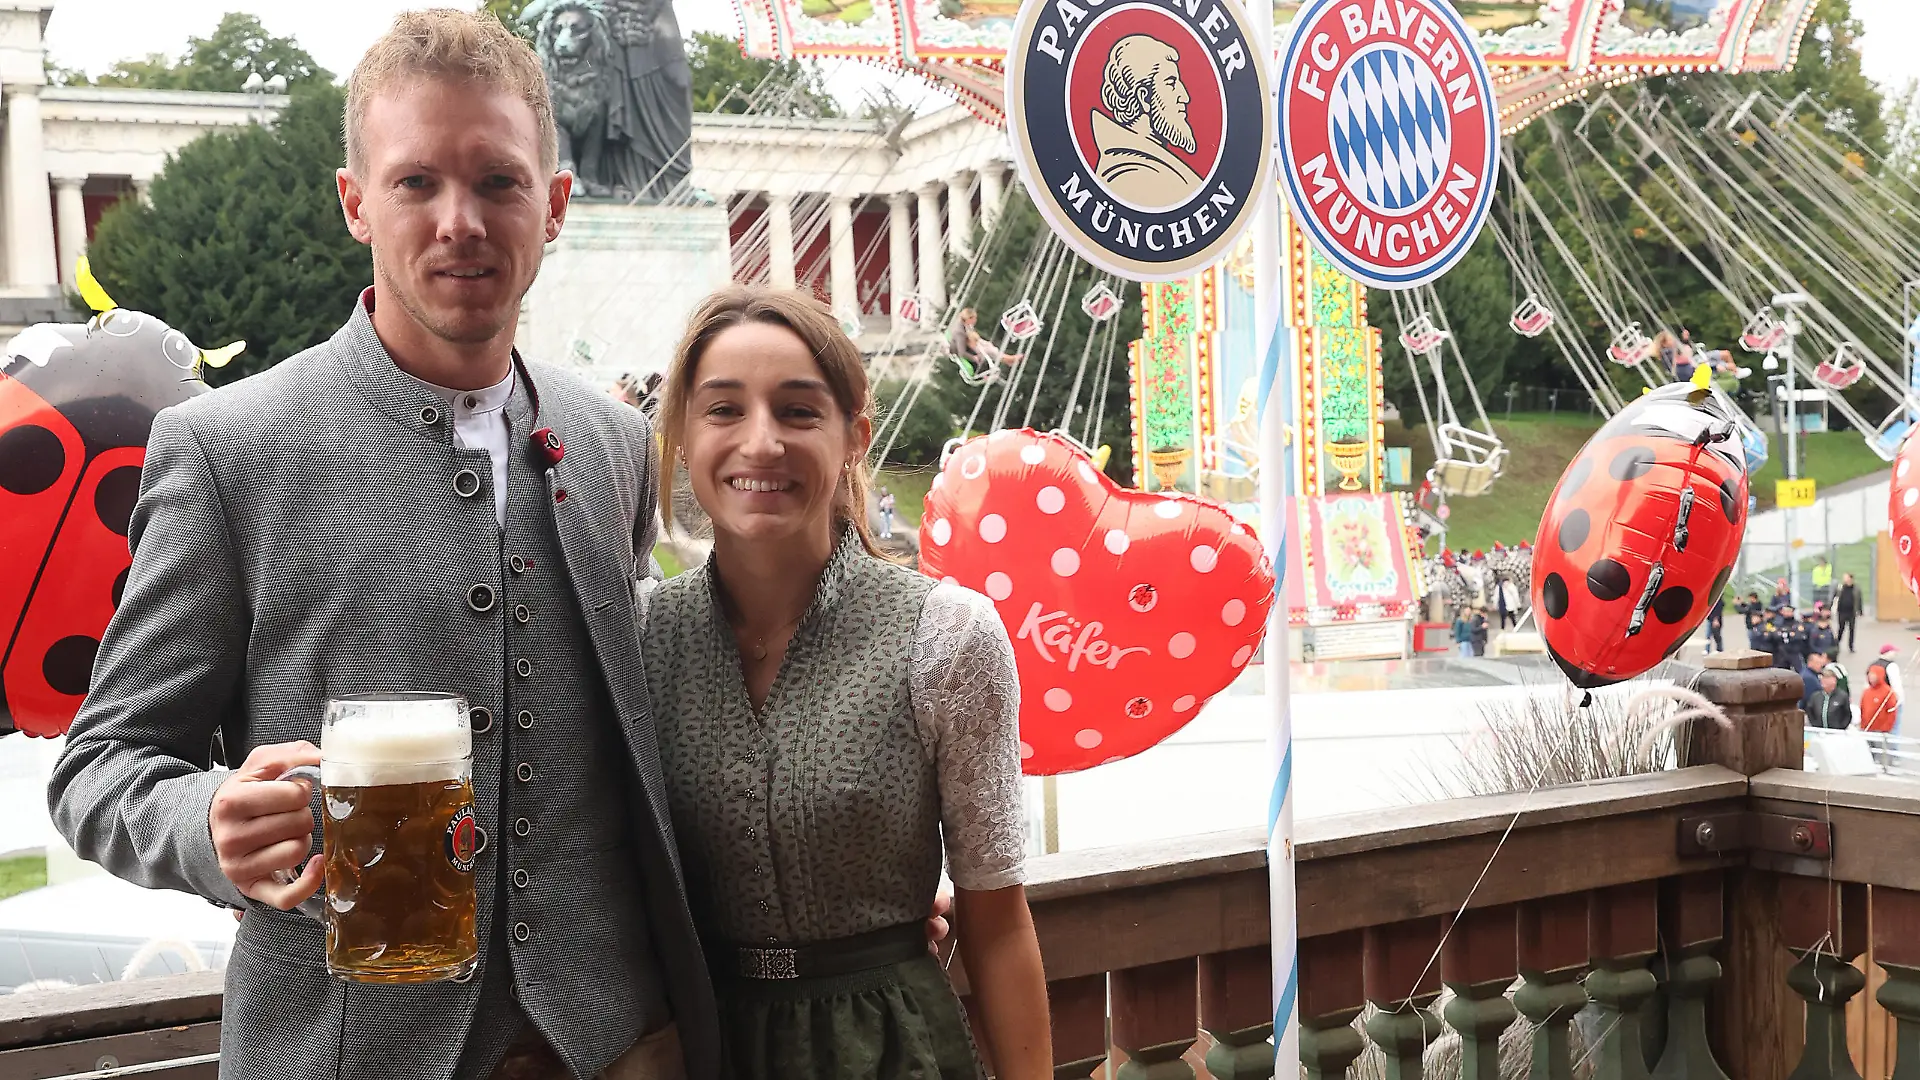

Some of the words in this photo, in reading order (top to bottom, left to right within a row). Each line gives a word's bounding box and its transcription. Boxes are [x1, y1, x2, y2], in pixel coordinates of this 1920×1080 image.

[1036, 0, 1247, 81] PANER
[1297, 32, 1340, 102] FC
[1339, 0, 1477, 115] BAYERN
[1059, 171, 1236, 251] MÜNCHEN
[1301, 152, 1477, 261] MÜNCHEN
[1016, 601, 1151, 672] Käfer
